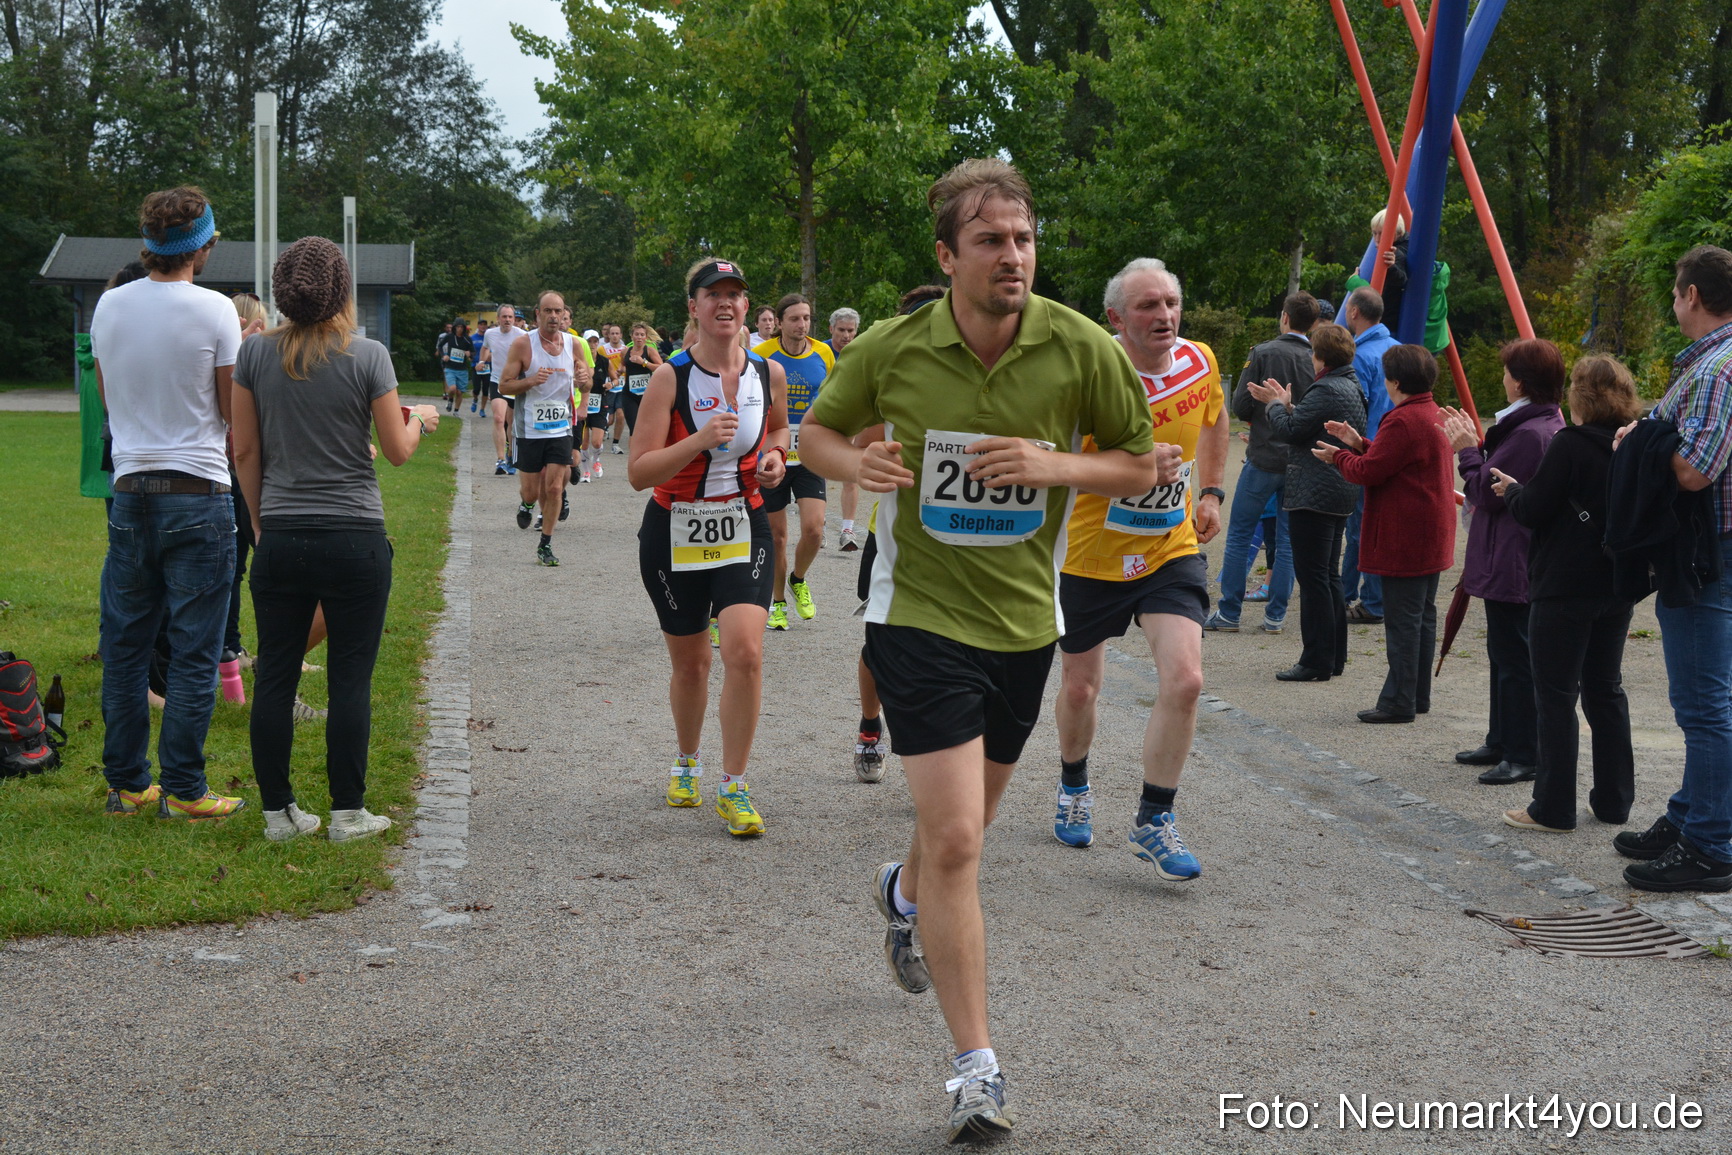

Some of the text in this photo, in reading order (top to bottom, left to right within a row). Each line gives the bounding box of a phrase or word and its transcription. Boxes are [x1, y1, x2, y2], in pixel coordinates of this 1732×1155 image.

[695, 399, 712, 407] tkn
[536, 408, 566, 421] 2467
[700, 506, 735, 516] Neumarkt
[949, 513, 1015, 534] Stephan
[1129, 515, 1168, 527] Johann
[687, 516, 736, 544] 280
[703, 549, 721, 560] Eva
